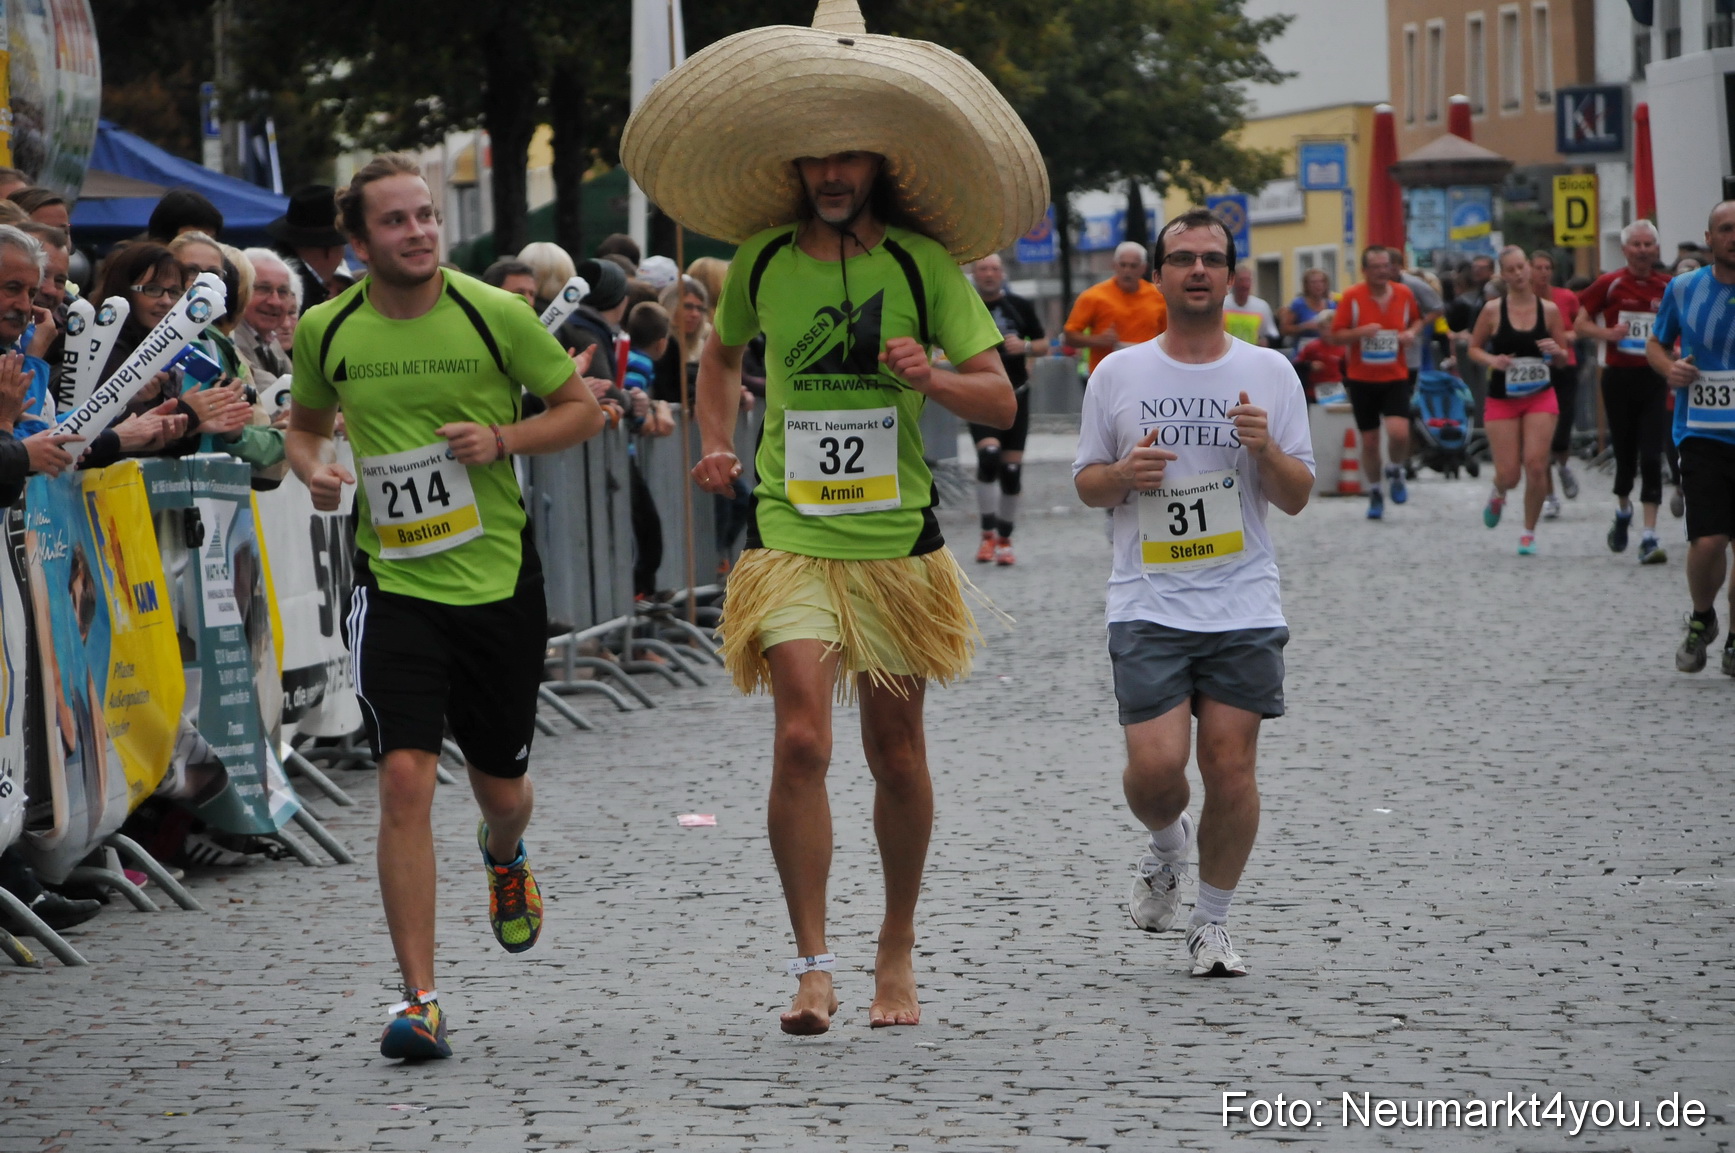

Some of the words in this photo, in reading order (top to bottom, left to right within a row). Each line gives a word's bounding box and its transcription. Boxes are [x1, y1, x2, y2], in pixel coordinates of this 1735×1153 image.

[1559, 177, 1594, 190] Block
[1566, 196, 1589, 229] D
[784, 318, 830, 368] GOSSEN
[349, 361, 399, 380] GOSSEN
[402, 359, 479, 375] METRAWATT
[793, 379, 879, 391] METRAWATT
[1694, 384, 1735, 406] 333
[787, 421, 822, 431] PARTL
[825, 420, 879, 431] Neumarkt
[363, 466, 389, 477] PARTL
[389, 454, 442, 474] Neumarkt
[819, 436, 865, 475] 32
[382, 470, 450, 518] 214
[821, 485, 864, 501] Armin
[1171, 482, 1219, 497] Neumarkt
[1167, 498, 1207, 536] 31
[397, 521, 451, 544] Bastian
[1170, 542, 1214, 559] Stefan
